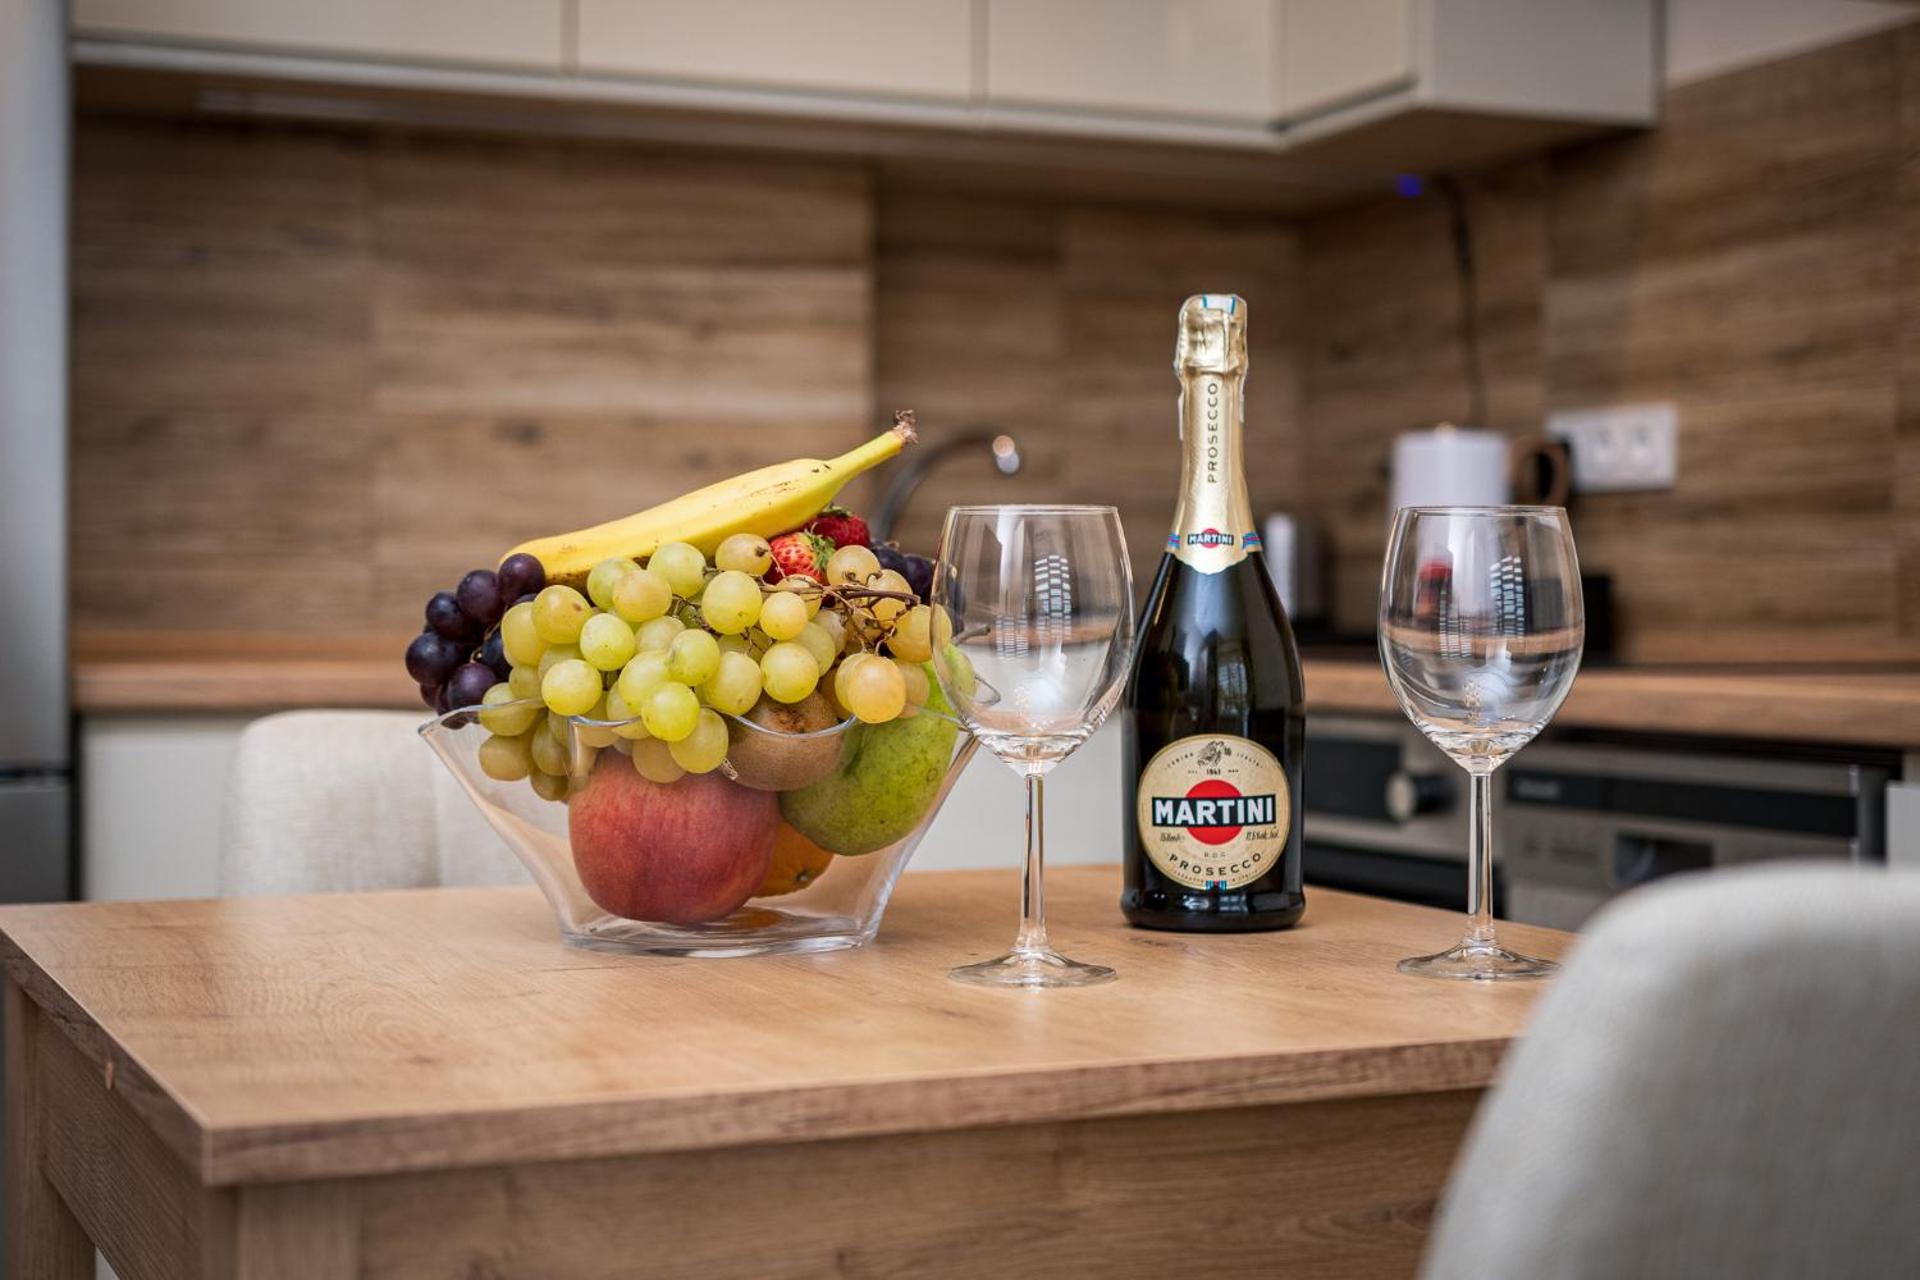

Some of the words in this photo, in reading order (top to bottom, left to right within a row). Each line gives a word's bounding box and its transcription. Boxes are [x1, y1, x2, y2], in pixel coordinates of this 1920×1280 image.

[1207, 382, 1219, 484] PROSECCO
[1188, 534, 1232, 545] MARTINI
[1154, 797, 1273, 825] MARTINI
[1168, 852, 1262, 876] PROSECCO
